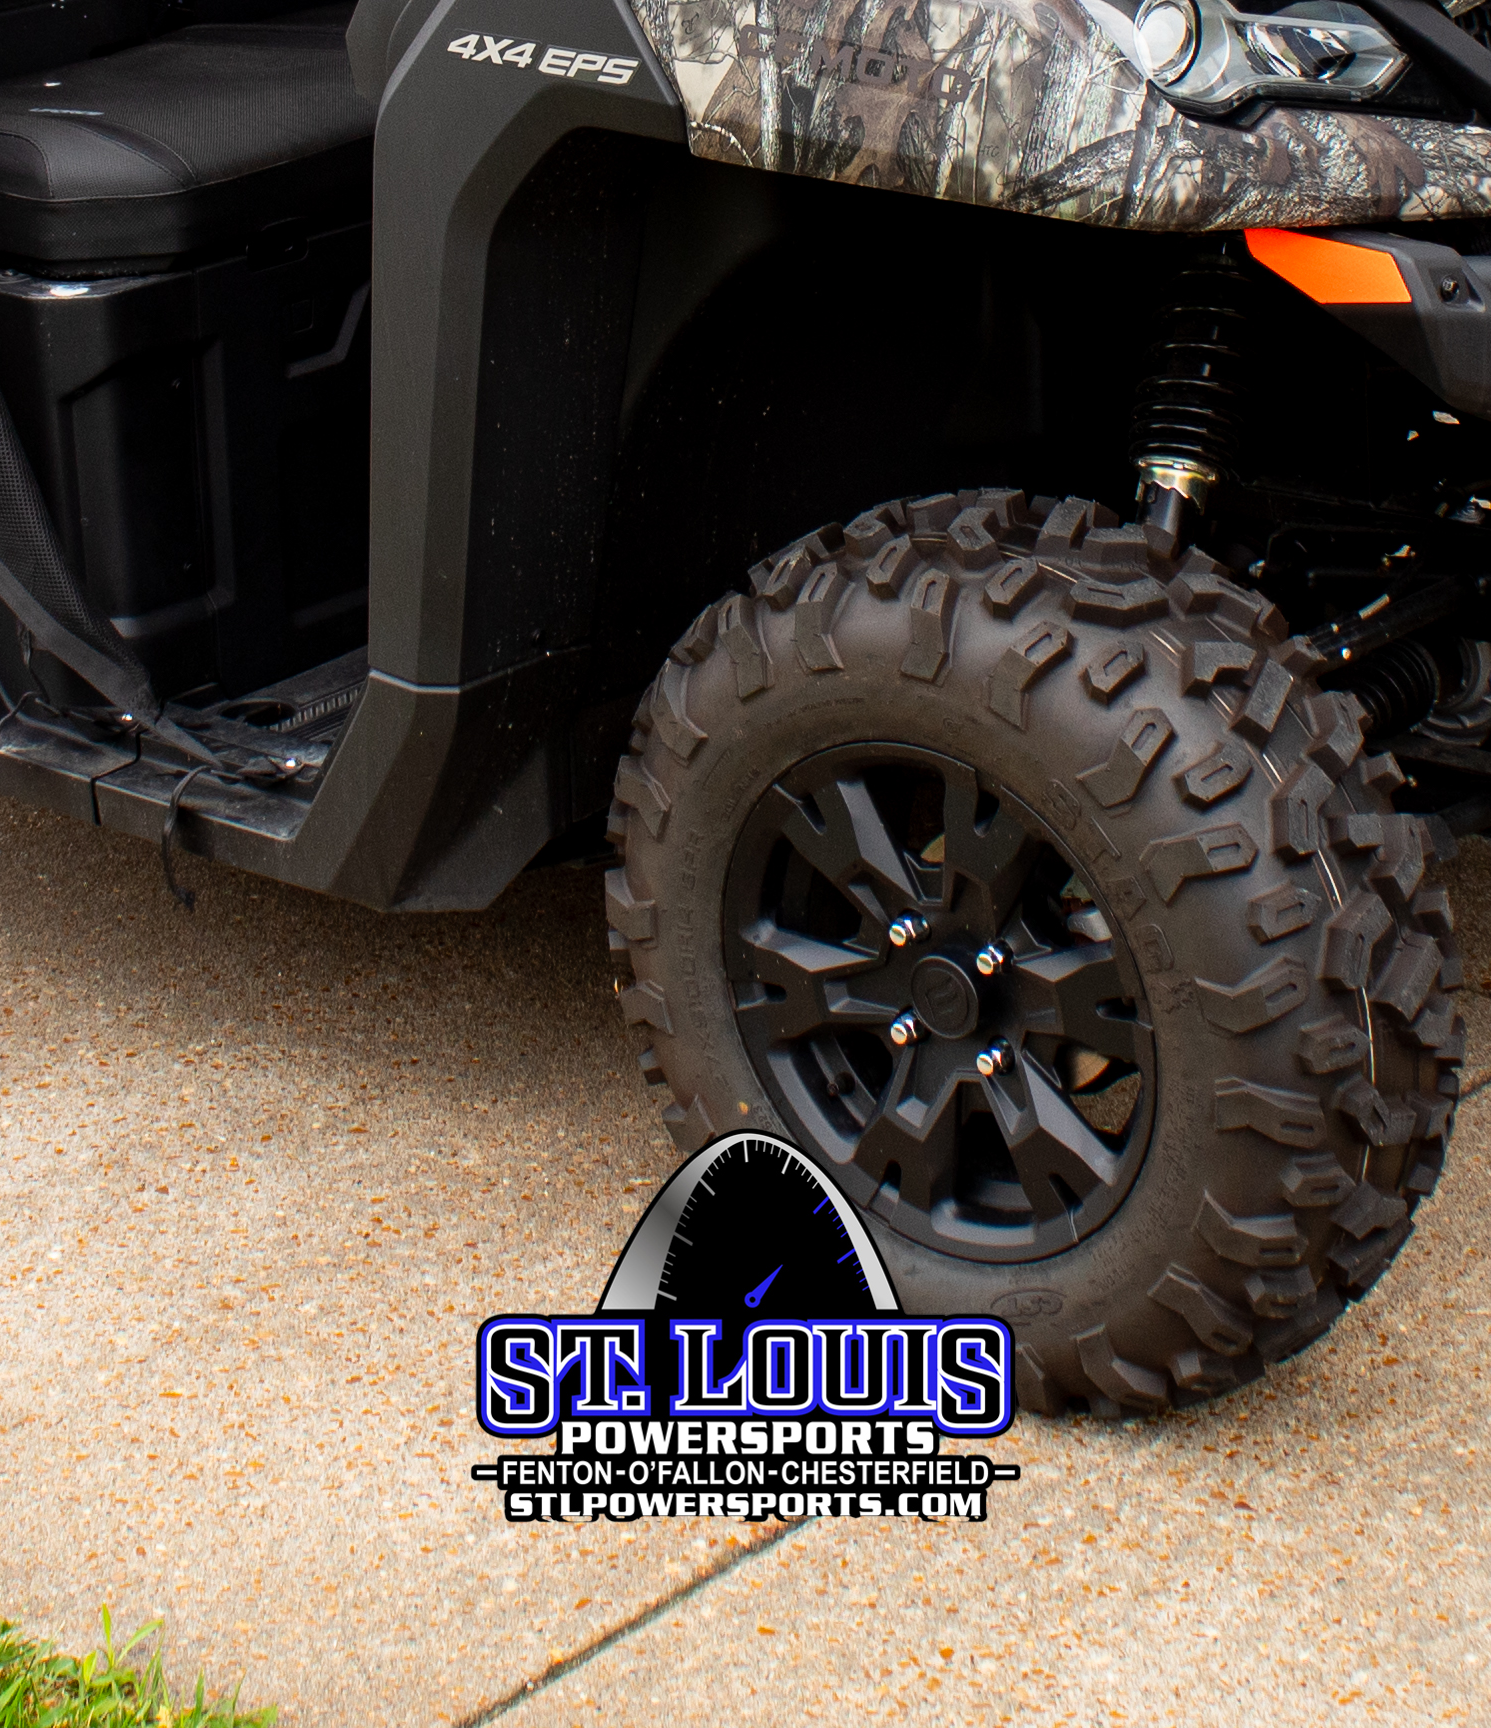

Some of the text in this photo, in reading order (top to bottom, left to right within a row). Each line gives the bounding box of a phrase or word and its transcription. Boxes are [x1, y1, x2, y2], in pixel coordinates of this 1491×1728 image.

[446, 33, 641, 85] 4X4 EPS
[738, 23, 974, 103] CFMOTO
